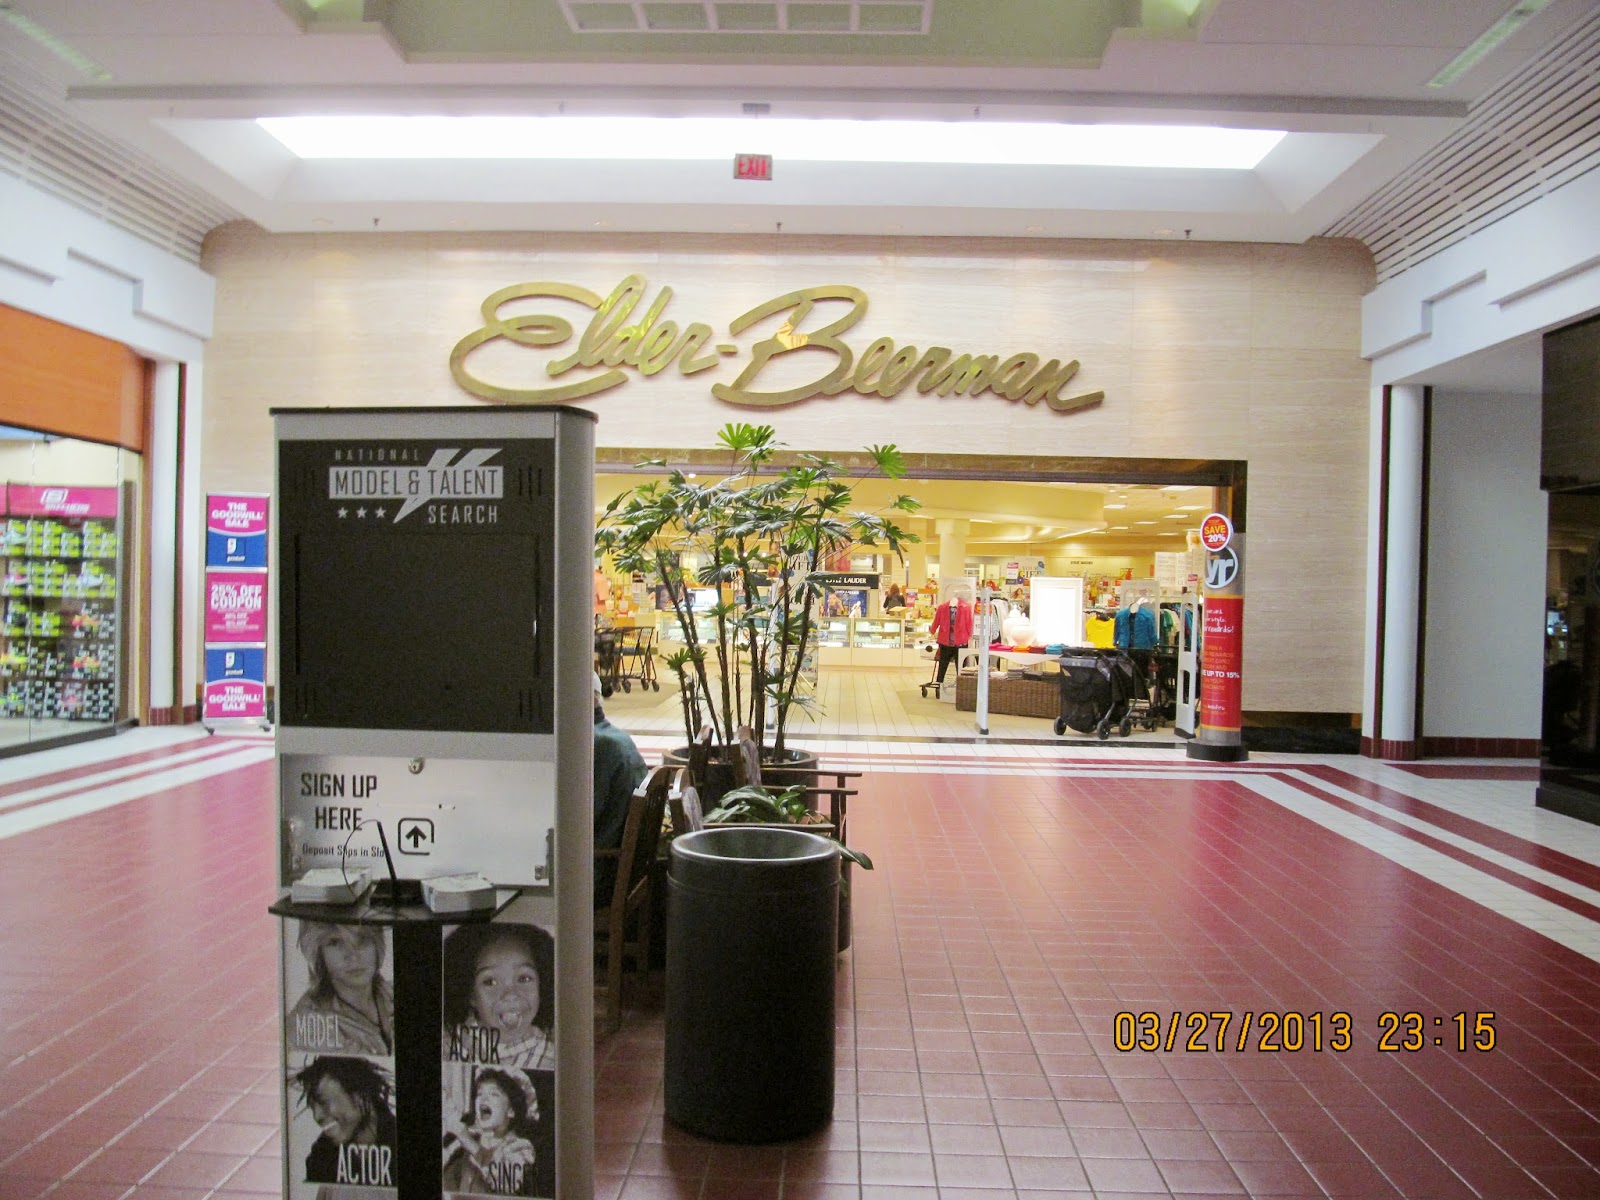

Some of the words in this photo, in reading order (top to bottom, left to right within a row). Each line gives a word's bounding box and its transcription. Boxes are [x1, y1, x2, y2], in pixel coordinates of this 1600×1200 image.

[737, 157, 768, 177] EXIT
[449, 272, 1105, 412] Elder-Beerman
[335, 449, 419, 461] NATIONAL
[335, 469, 402, 496] MODEL
[408, 469, 421, 496] &
[427, 469, 498, 496] TALENT
[428, 505, 498, 524] SEARCH
[1204, 525, 1226, 534] SAVE
[1208, 534, 1226, 543] 20%
[240, 584, 262, 598] OFF
[211, 596, 262, 610] COUPON
[1226, 671, 1240, 679] 15%
[301, 773, 345, 798] SIGN
[352, 774, 378, 799] UP
[315, 806, 363, 832] HERE
[302, 842, 334, 856] Deposit
[361, 846, 369, 857] in
[371, 845, 385, 858] Slo
[296, 1013, 343, 1049] MODEL
[450, 1023, 500, 1065] ACTOR
[336, 1144, 392, 1186] ACTOR
[488, 1160, 539, 1197] SING
